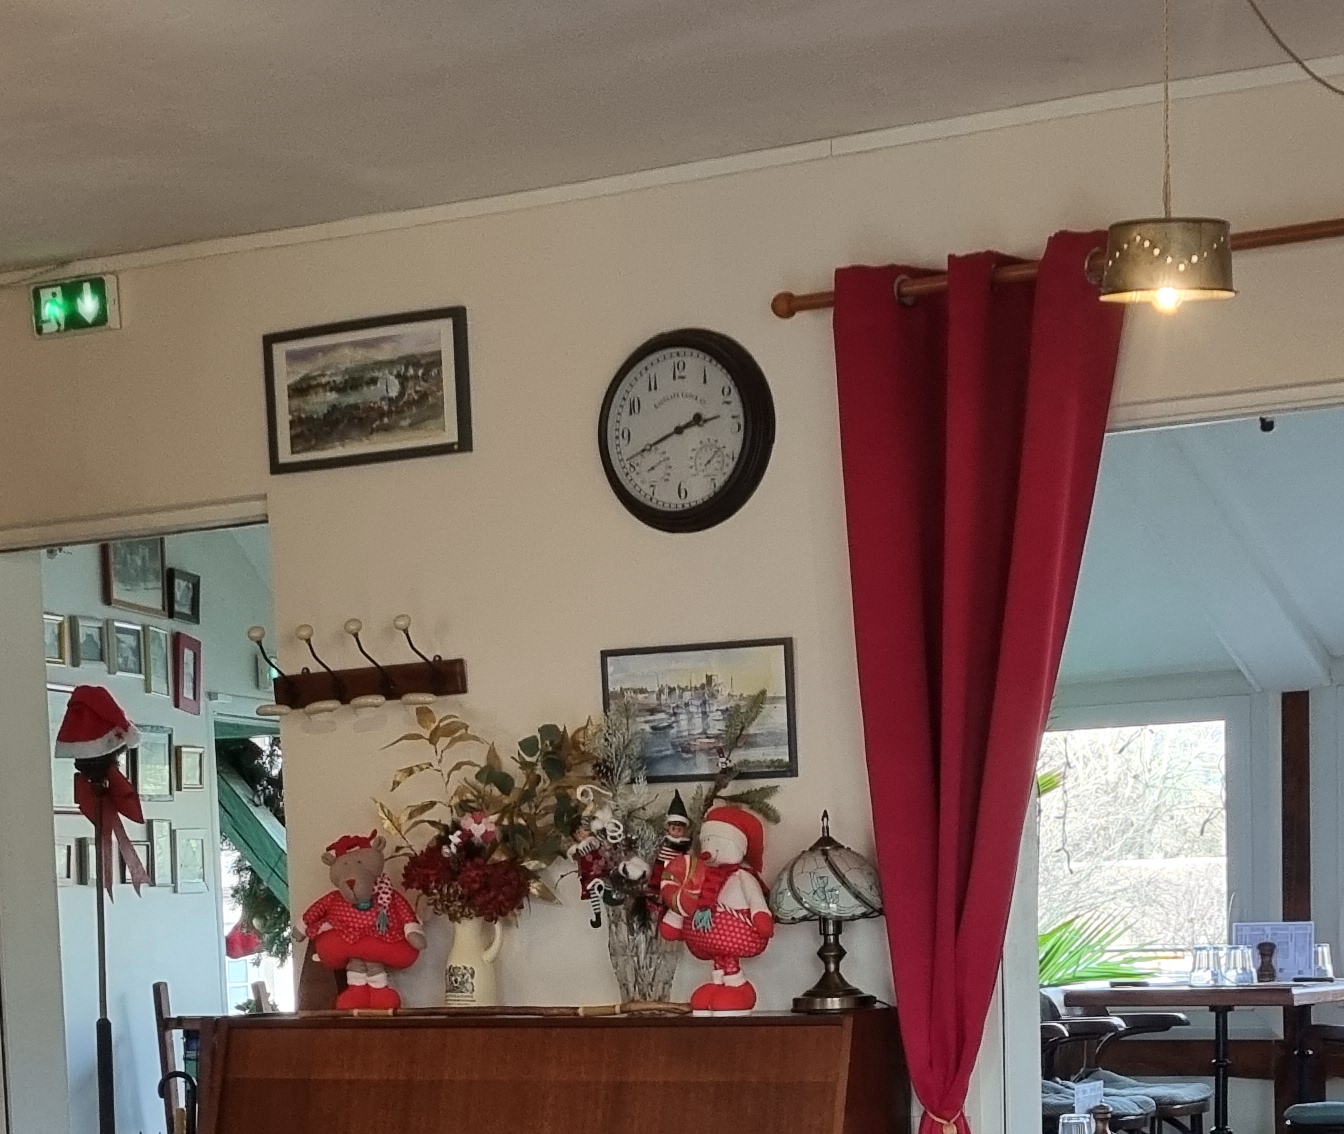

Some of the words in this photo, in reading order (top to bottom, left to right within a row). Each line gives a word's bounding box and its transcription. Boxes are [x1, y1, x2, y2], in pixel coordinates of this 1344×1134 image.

[672, 359, 687, 382] 12
[702, 365, 707, 385] 1
[647, 372, 658, 392] 11
[721, 384, 733, 405] 2
[628, 395, 641, 416] 10
[621, 426, 631, 446] 9
[677, 480, 688, 501] 6
